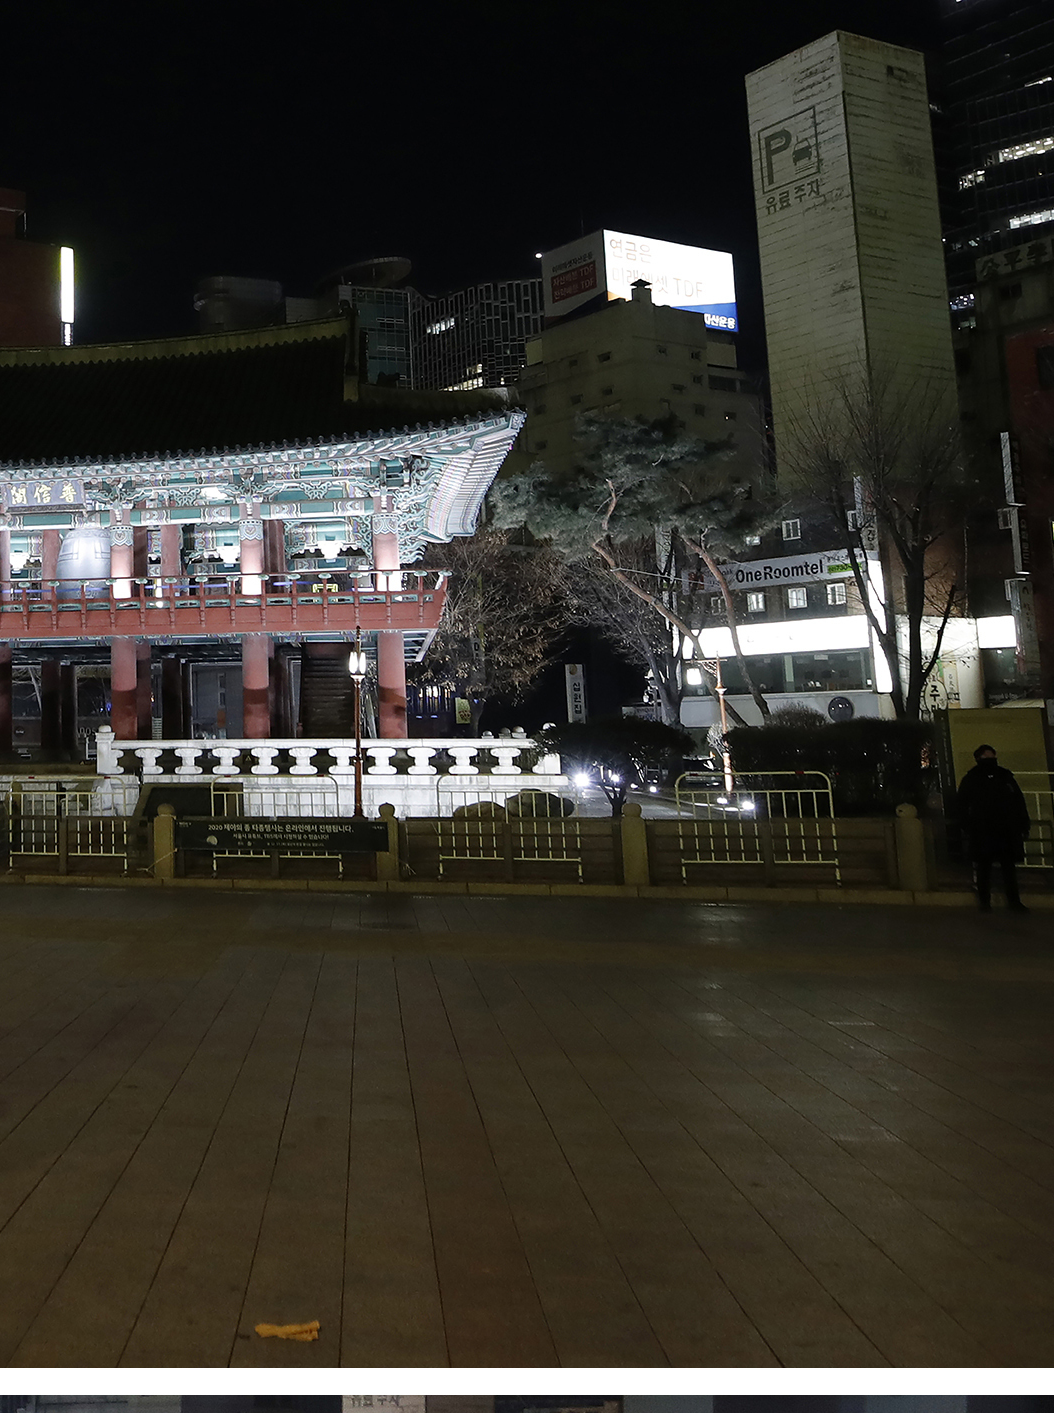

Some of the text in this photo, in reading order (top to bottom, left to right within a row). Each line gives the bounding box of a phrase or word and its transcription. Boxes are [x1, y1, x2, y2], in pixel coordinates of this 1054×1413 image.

[609, 238, 652, 263] 연금은
[580, 264, 594, 277] TDF
[581, 277, 595, 290] TDF
[673, 277, 704, 299] TDF
